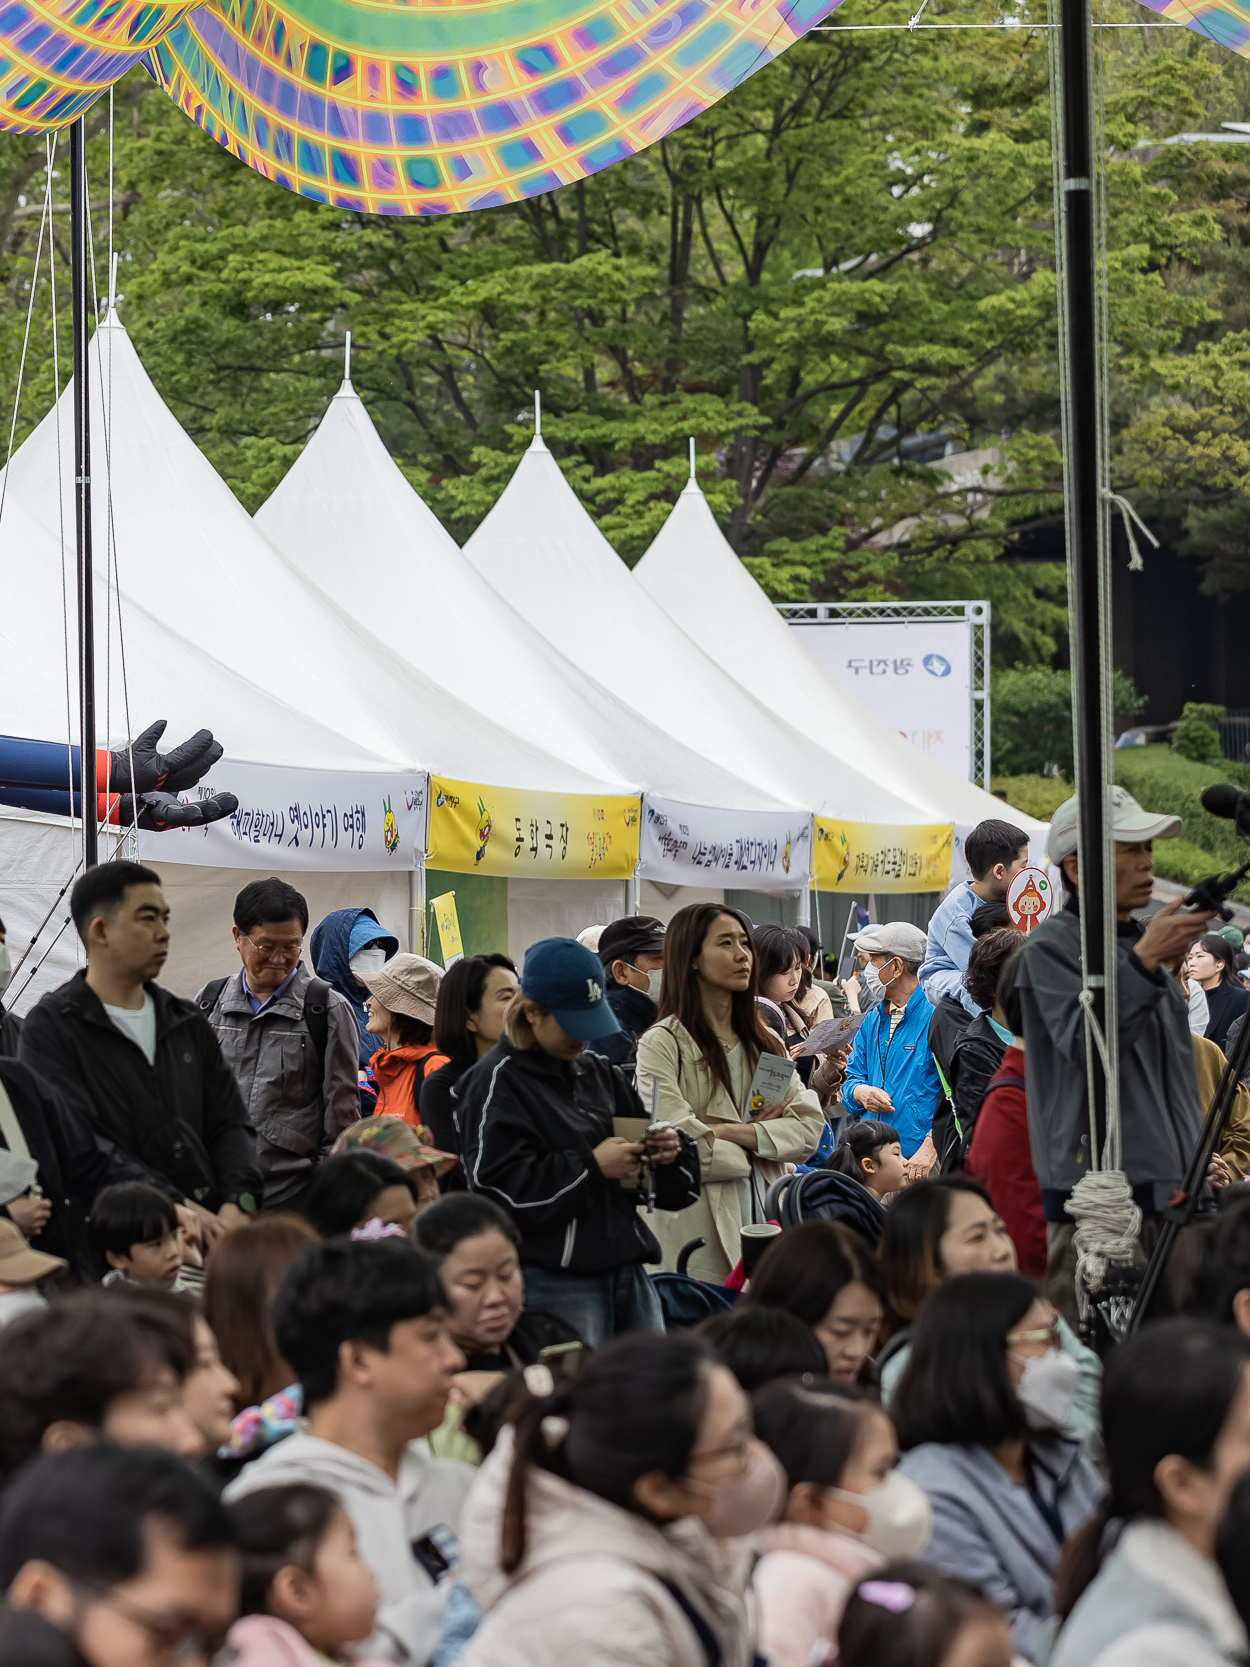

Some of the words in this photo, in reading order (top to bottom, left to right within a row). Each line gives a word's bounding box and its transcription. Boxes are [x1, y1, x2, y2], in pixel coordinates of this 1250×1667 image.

[230, 808, 285, 845] 해피할머니
[288, 802, 338, 849] 옛이야기
[343, 804, 366, 849] 여행
[514, 817, 570, 861] 동화극장
[586, 979, 602, 1002] LA
